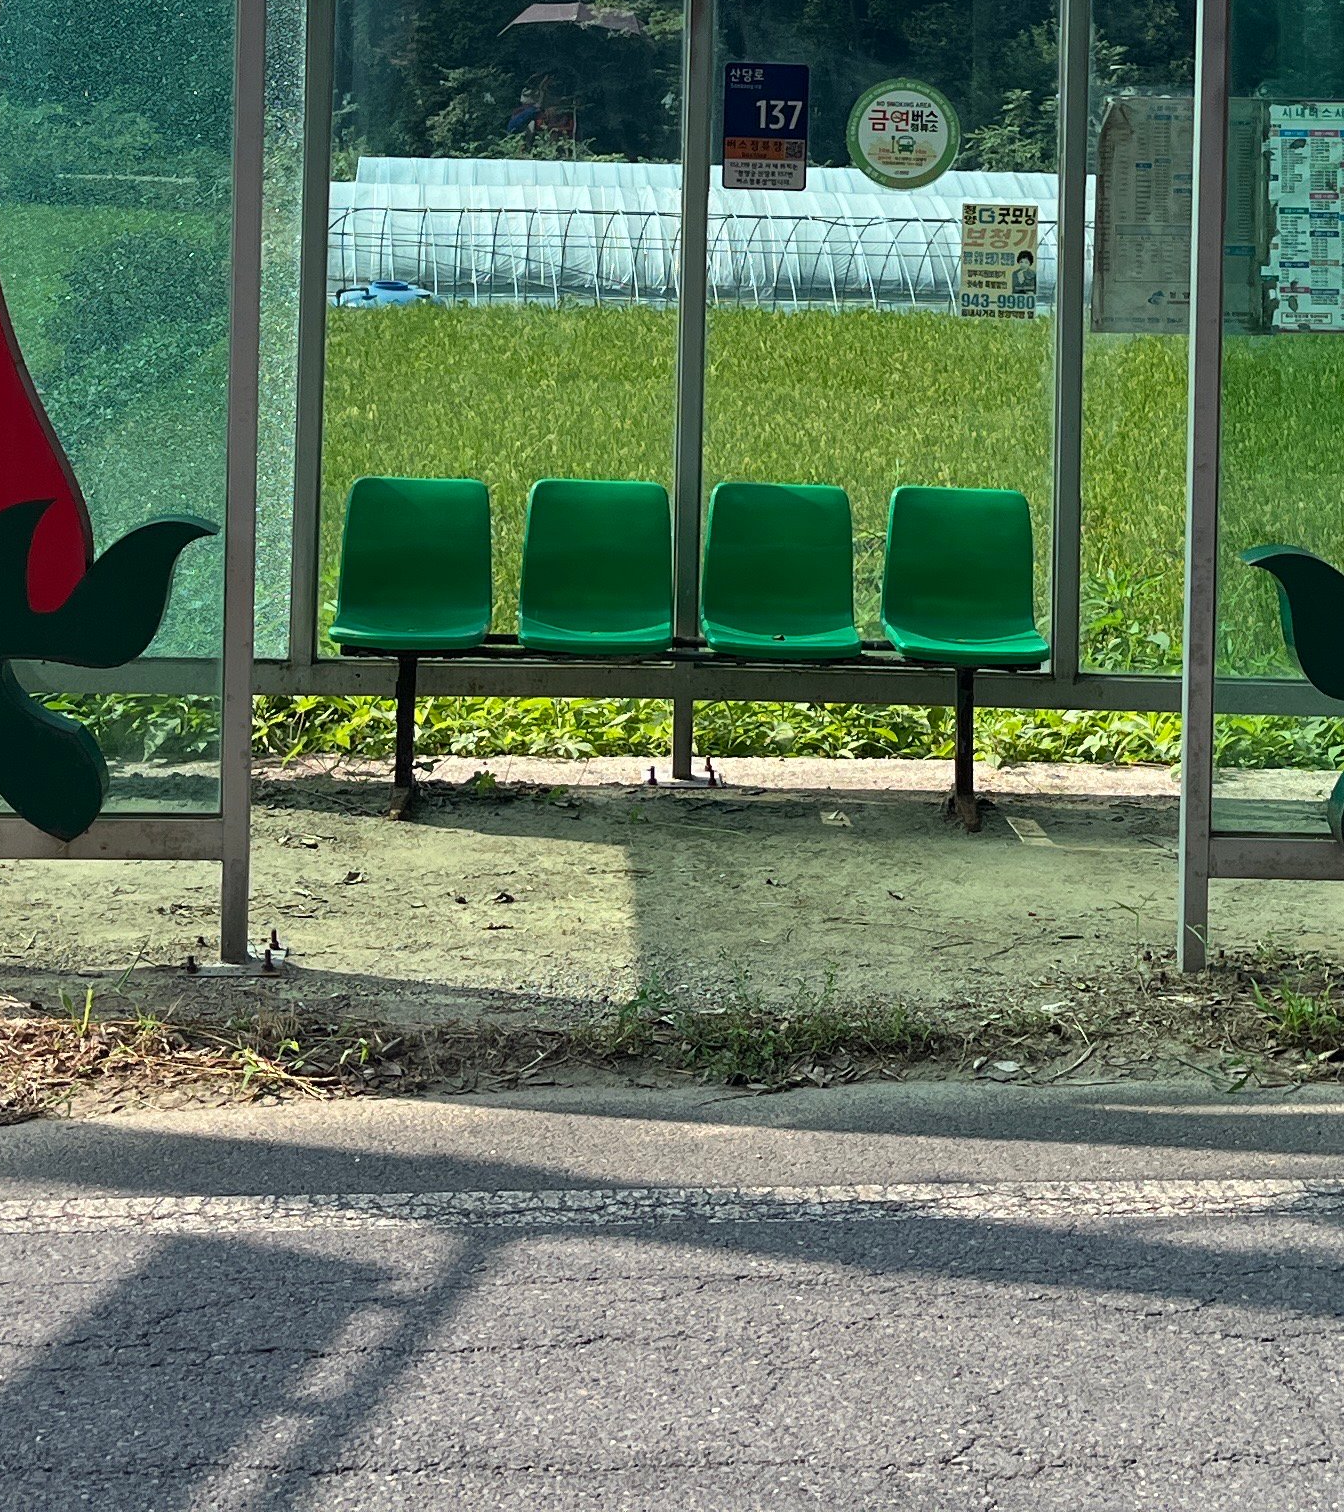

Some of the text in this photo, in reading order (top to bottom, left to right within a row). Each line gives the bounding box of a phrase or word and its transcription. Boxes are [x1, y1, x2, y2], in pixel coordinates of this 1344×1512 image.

[729, 67, 765, 83] 산당로
[755, 99, 803, 130] 137
[867, 109, 939, 132] 금연 버스
[910, 123, 939, 133] 정류소
[726, 139, 783, 153] 버스정류장
[997, 207, 1037, 226] 굿모닝
[963, 228, 1036, 249] 보청기
[961, 293, 1035, 309] 943-9980
